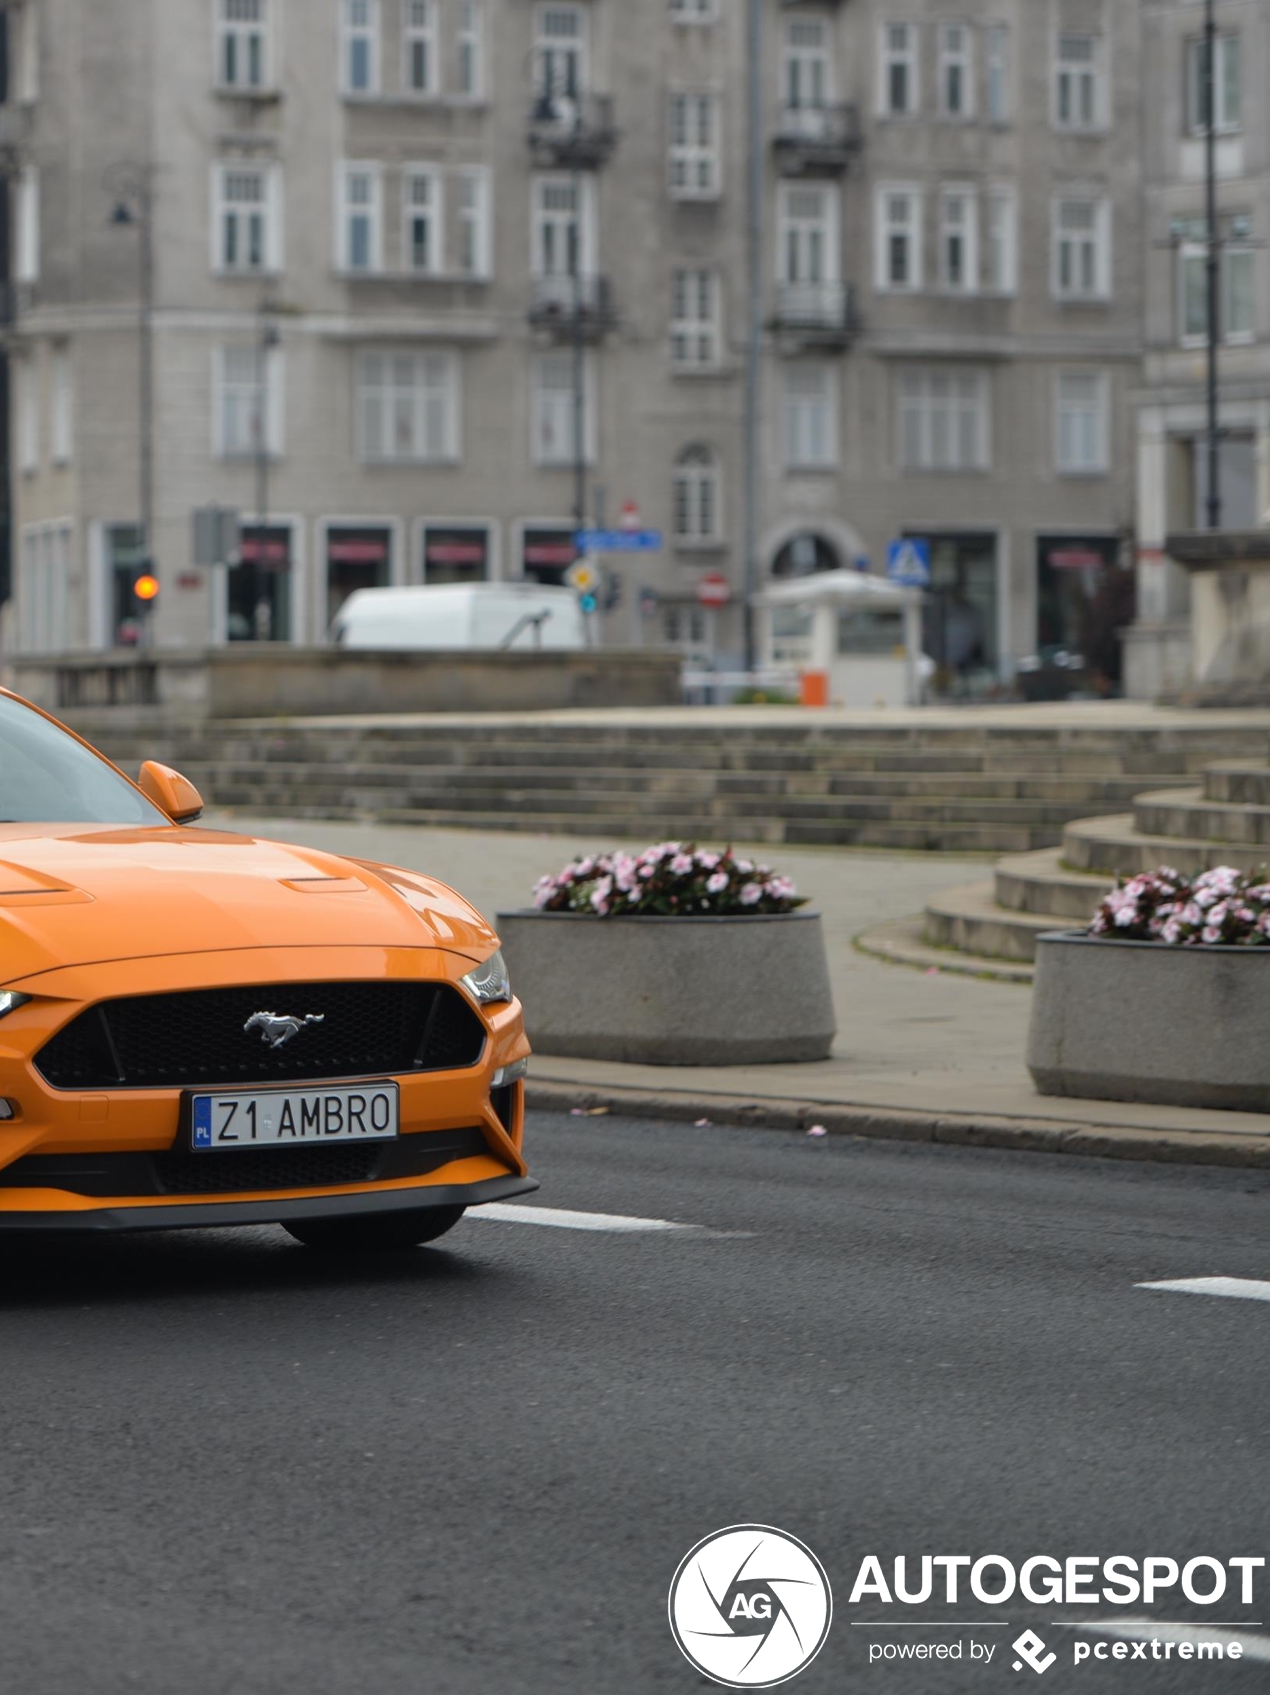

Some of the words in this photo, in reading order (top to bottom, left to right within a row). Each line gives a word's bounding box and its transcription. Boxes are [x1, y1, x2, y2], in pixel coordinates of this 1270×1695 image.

[218, 1100, 258, 1141] Z1
[277, 1093, 391, 1138] AMBRO
[196, 1127, 210, 1139] PL
